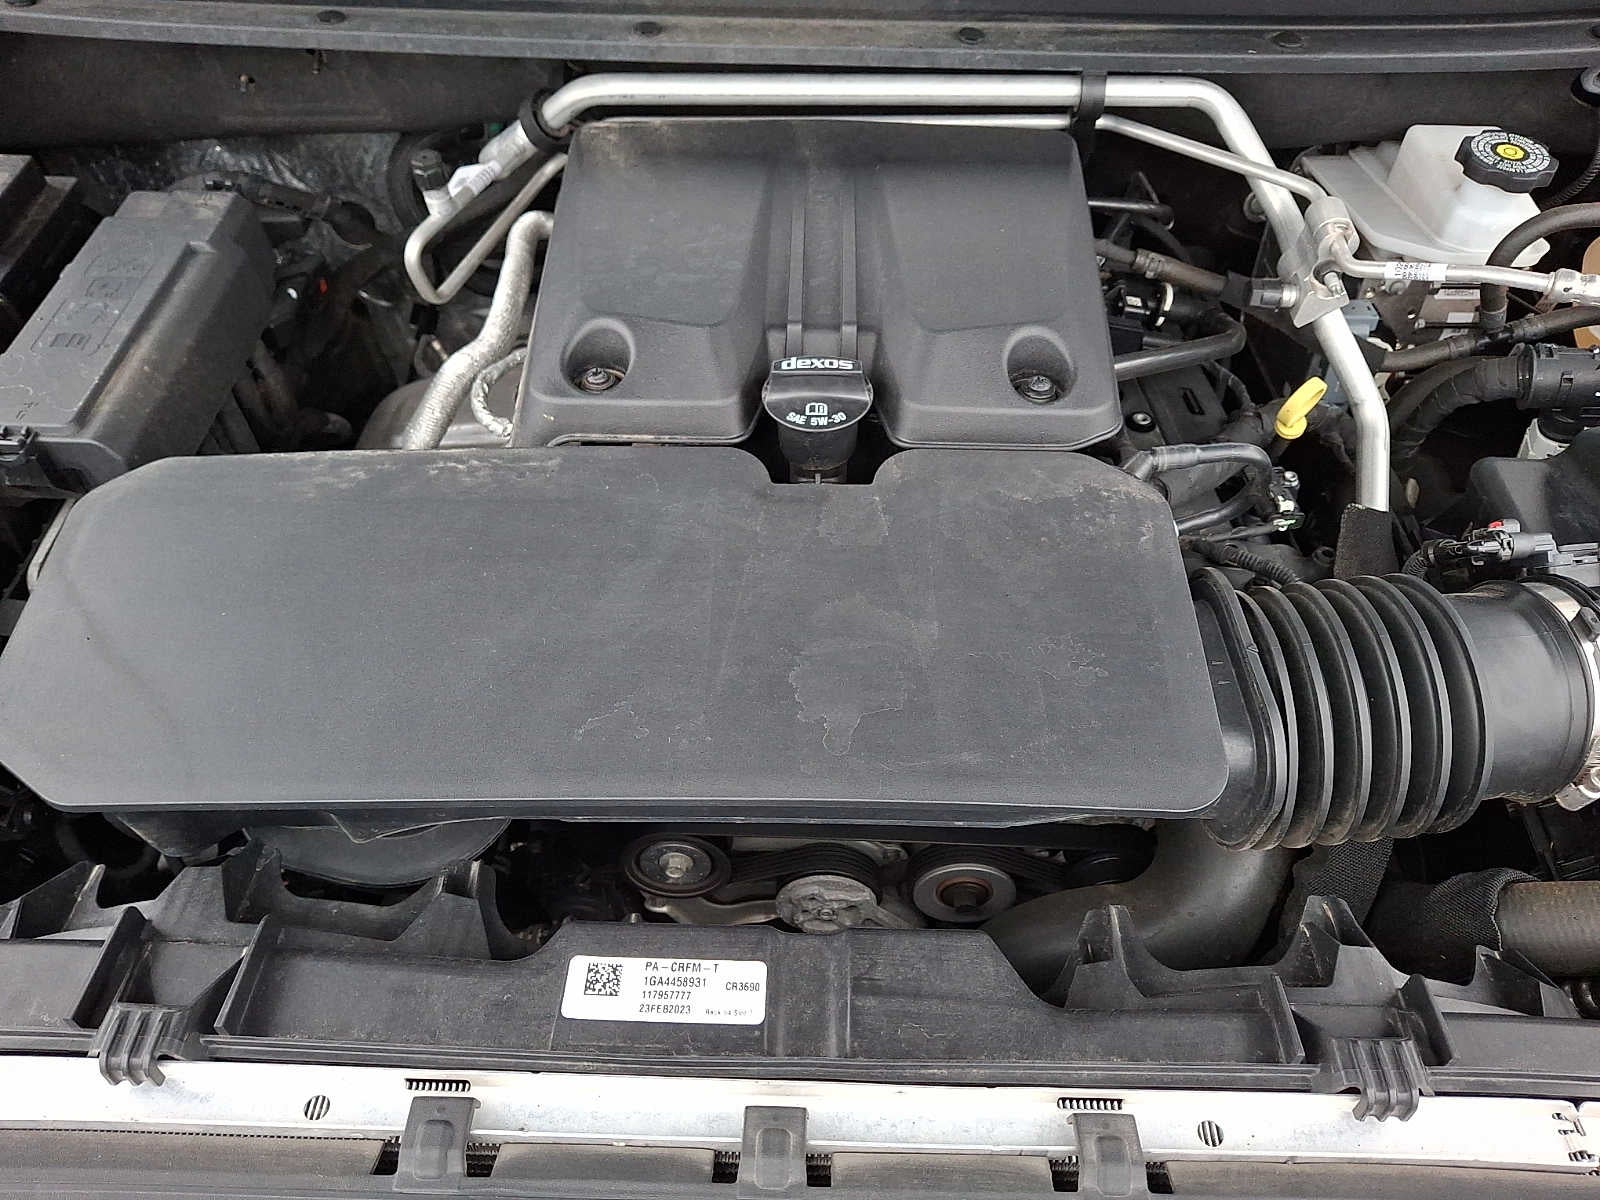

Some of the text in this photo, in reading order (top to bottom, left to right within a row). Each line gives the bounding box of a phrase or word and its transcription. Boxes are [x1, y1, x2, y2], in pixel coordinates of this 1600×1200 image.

[781, 357, 854, 370] dexos
[786, 412, 847, 426] SAE 5W-30
[644, 976, 707, 988] 1GA4458931
[725, 982, 760, 992] CR3690
[642, 991, 692, 1001] 117957777
